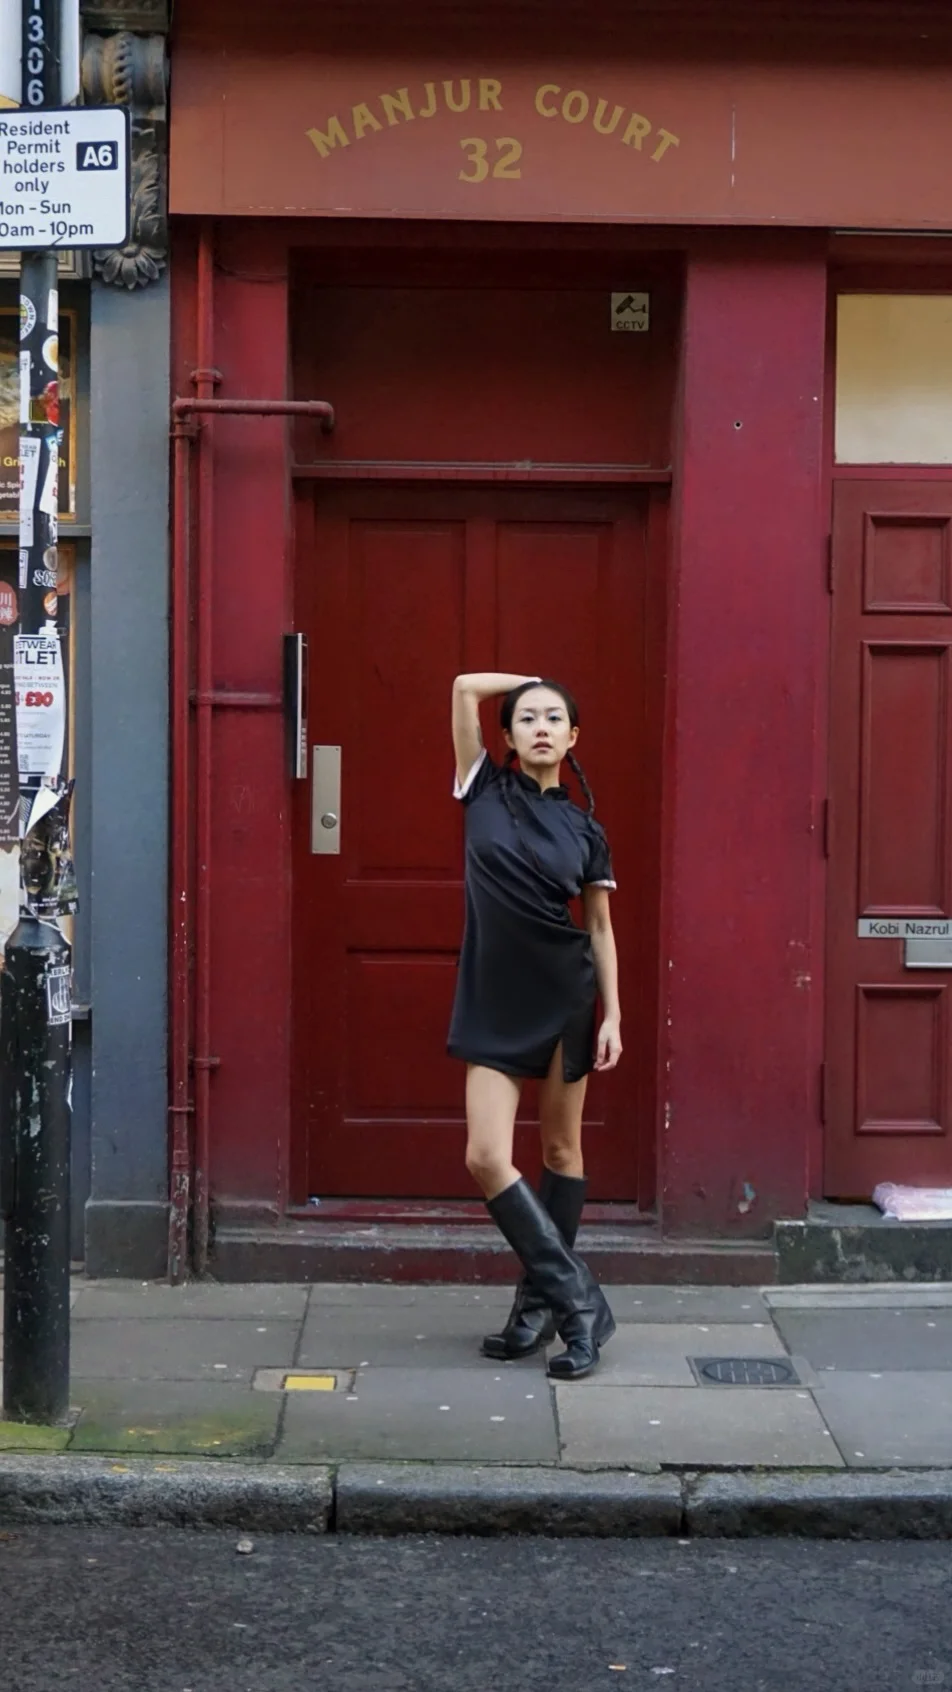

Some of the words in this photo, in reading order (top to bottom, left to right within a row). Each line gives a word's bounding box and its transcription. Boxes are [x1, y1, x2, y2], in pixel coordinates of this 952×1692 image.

[0, 120, 70, 136] Resident
[305, 78, 504, 158] MANJUR
[534, 84, 680, 163] COURT
[7, 140, 61, 154] Permit
[83, 145, 113, 167] A6
[458, 137, 523, 184] 32
[3, 159, 65, 174] holders
[14, 177, 49, 194] only
[40, 200, 71, 214] Sun
[49, 220, 94, 238] 10pm
[615, 320, 645, 330] CCTV
[869, 922, 899, 934] Kobi
[905, 923, 949, 935] Nazrul
